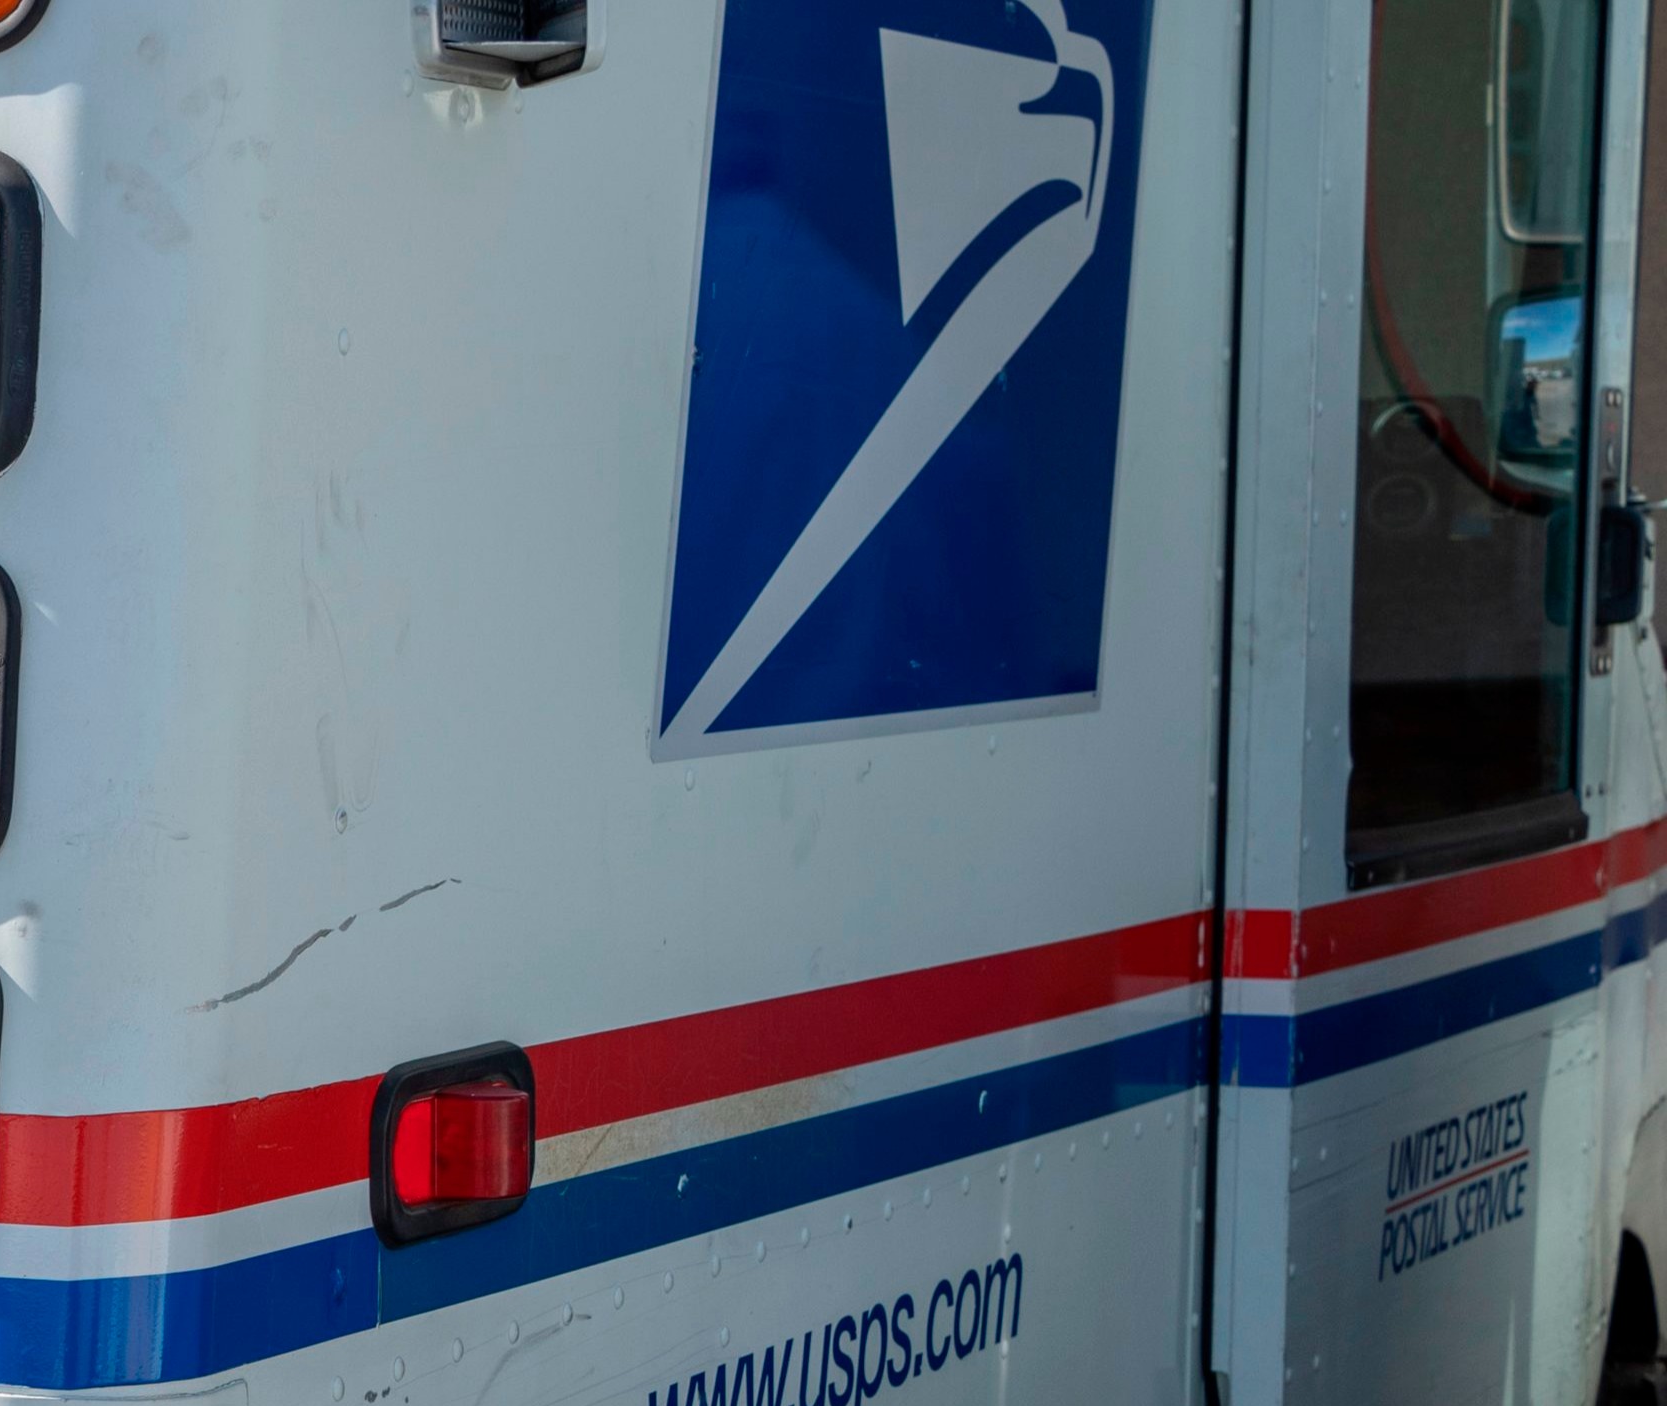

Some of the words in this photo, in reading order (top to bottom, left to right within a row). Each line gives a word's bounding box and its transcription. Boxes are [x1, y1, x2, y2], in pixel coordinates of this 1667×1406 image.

[1387, 1117, 1459, 1199] UNITED
[1460, 1092, 1528, 1166] STATES
[1379, 1196, 1448, 1282] POSTAL
[1453, 1161, 1528, 1246] SERVICE
